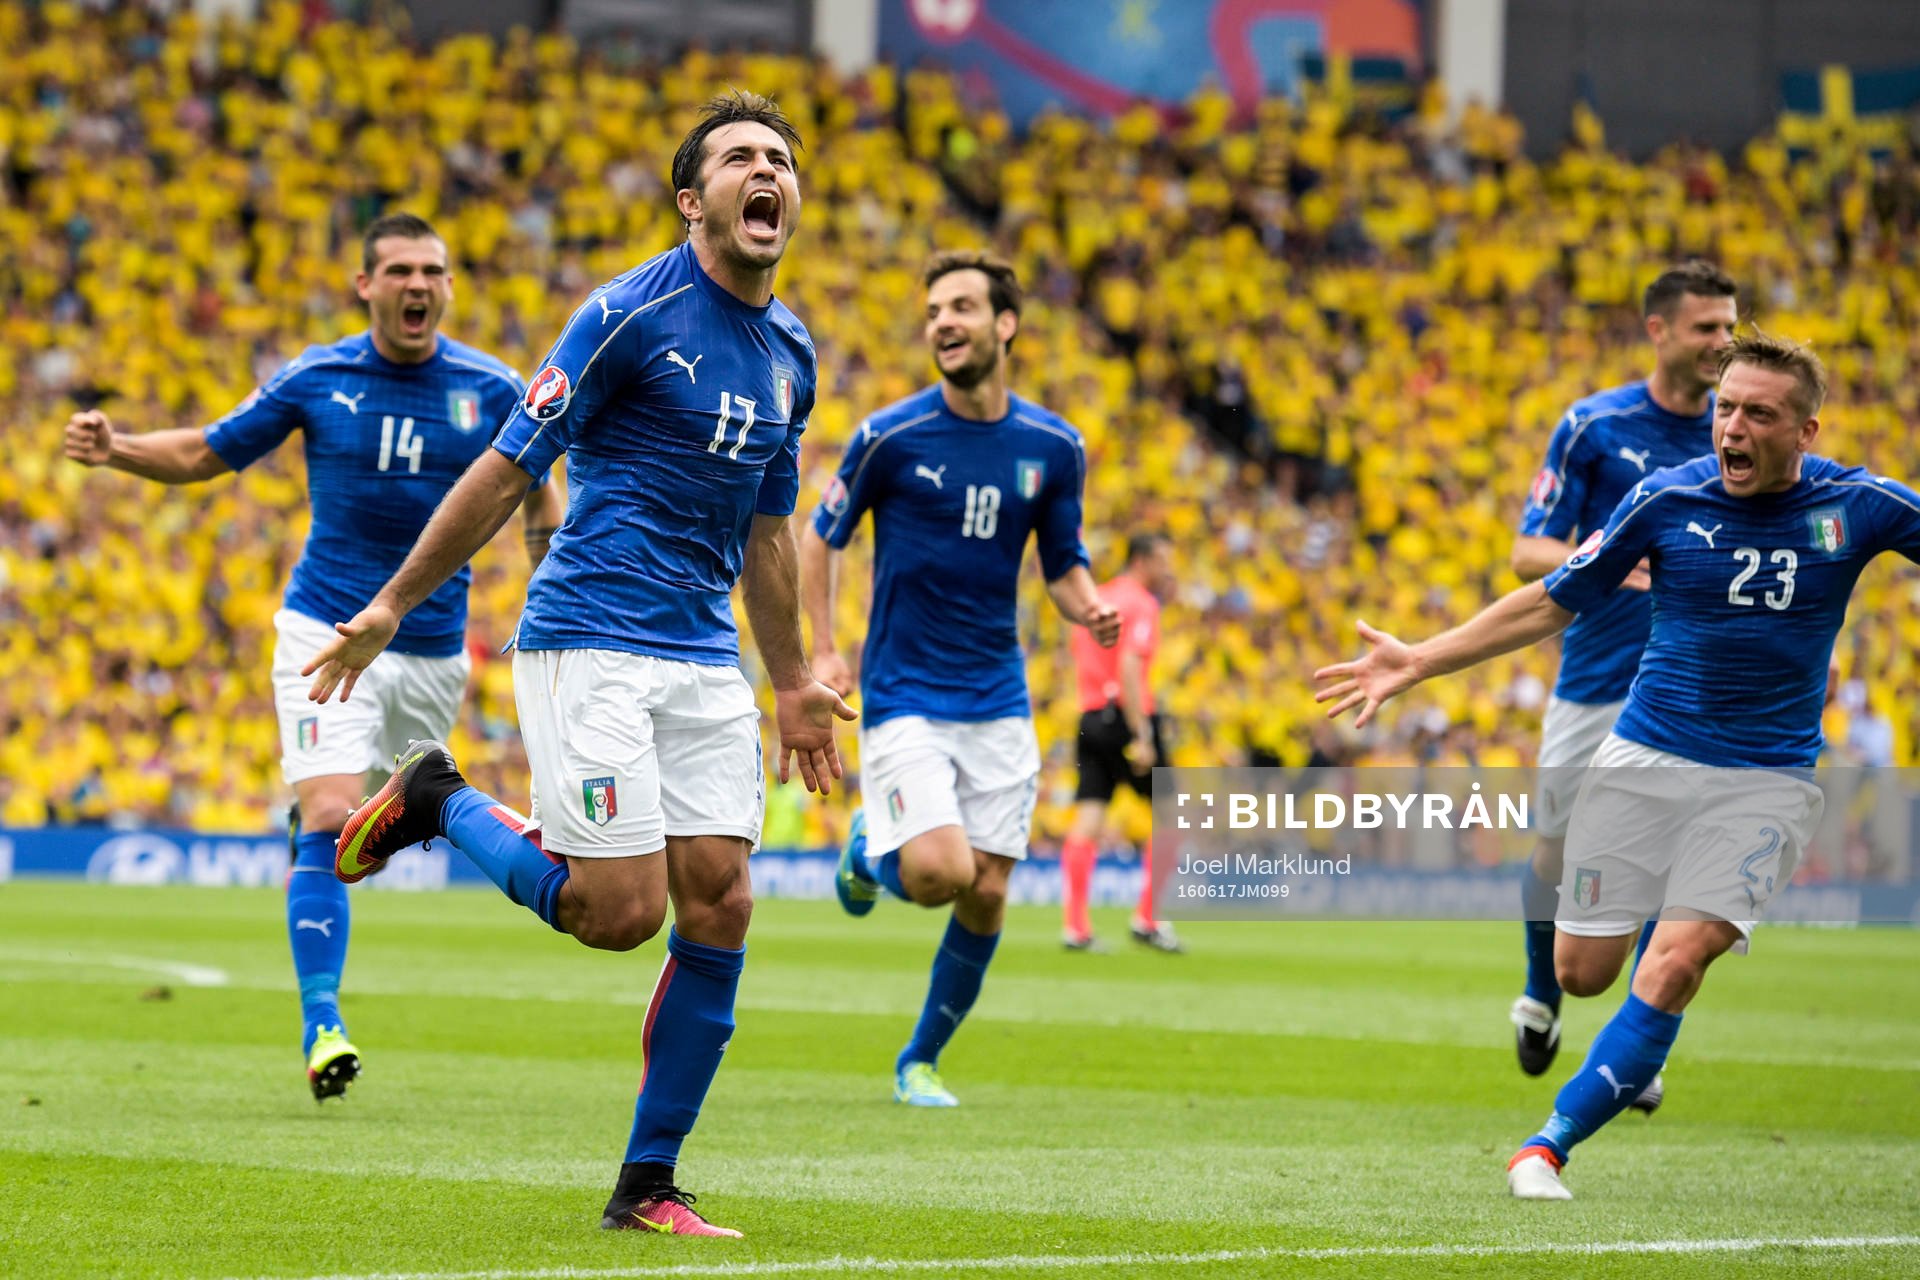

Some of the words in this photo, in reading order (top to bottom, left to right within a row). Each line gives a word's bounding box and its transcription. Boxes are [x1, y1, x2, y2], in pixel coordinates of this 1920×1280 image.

[377, 415, 424, 474] 14
[707, 391, 756, 460] 17
[962, 484, 1002, 539] 18
[1728, 547, 1798, 610] 23
[585, 779, 611, 787] ITALIA
[1738, 827, 1780, 893] 2
